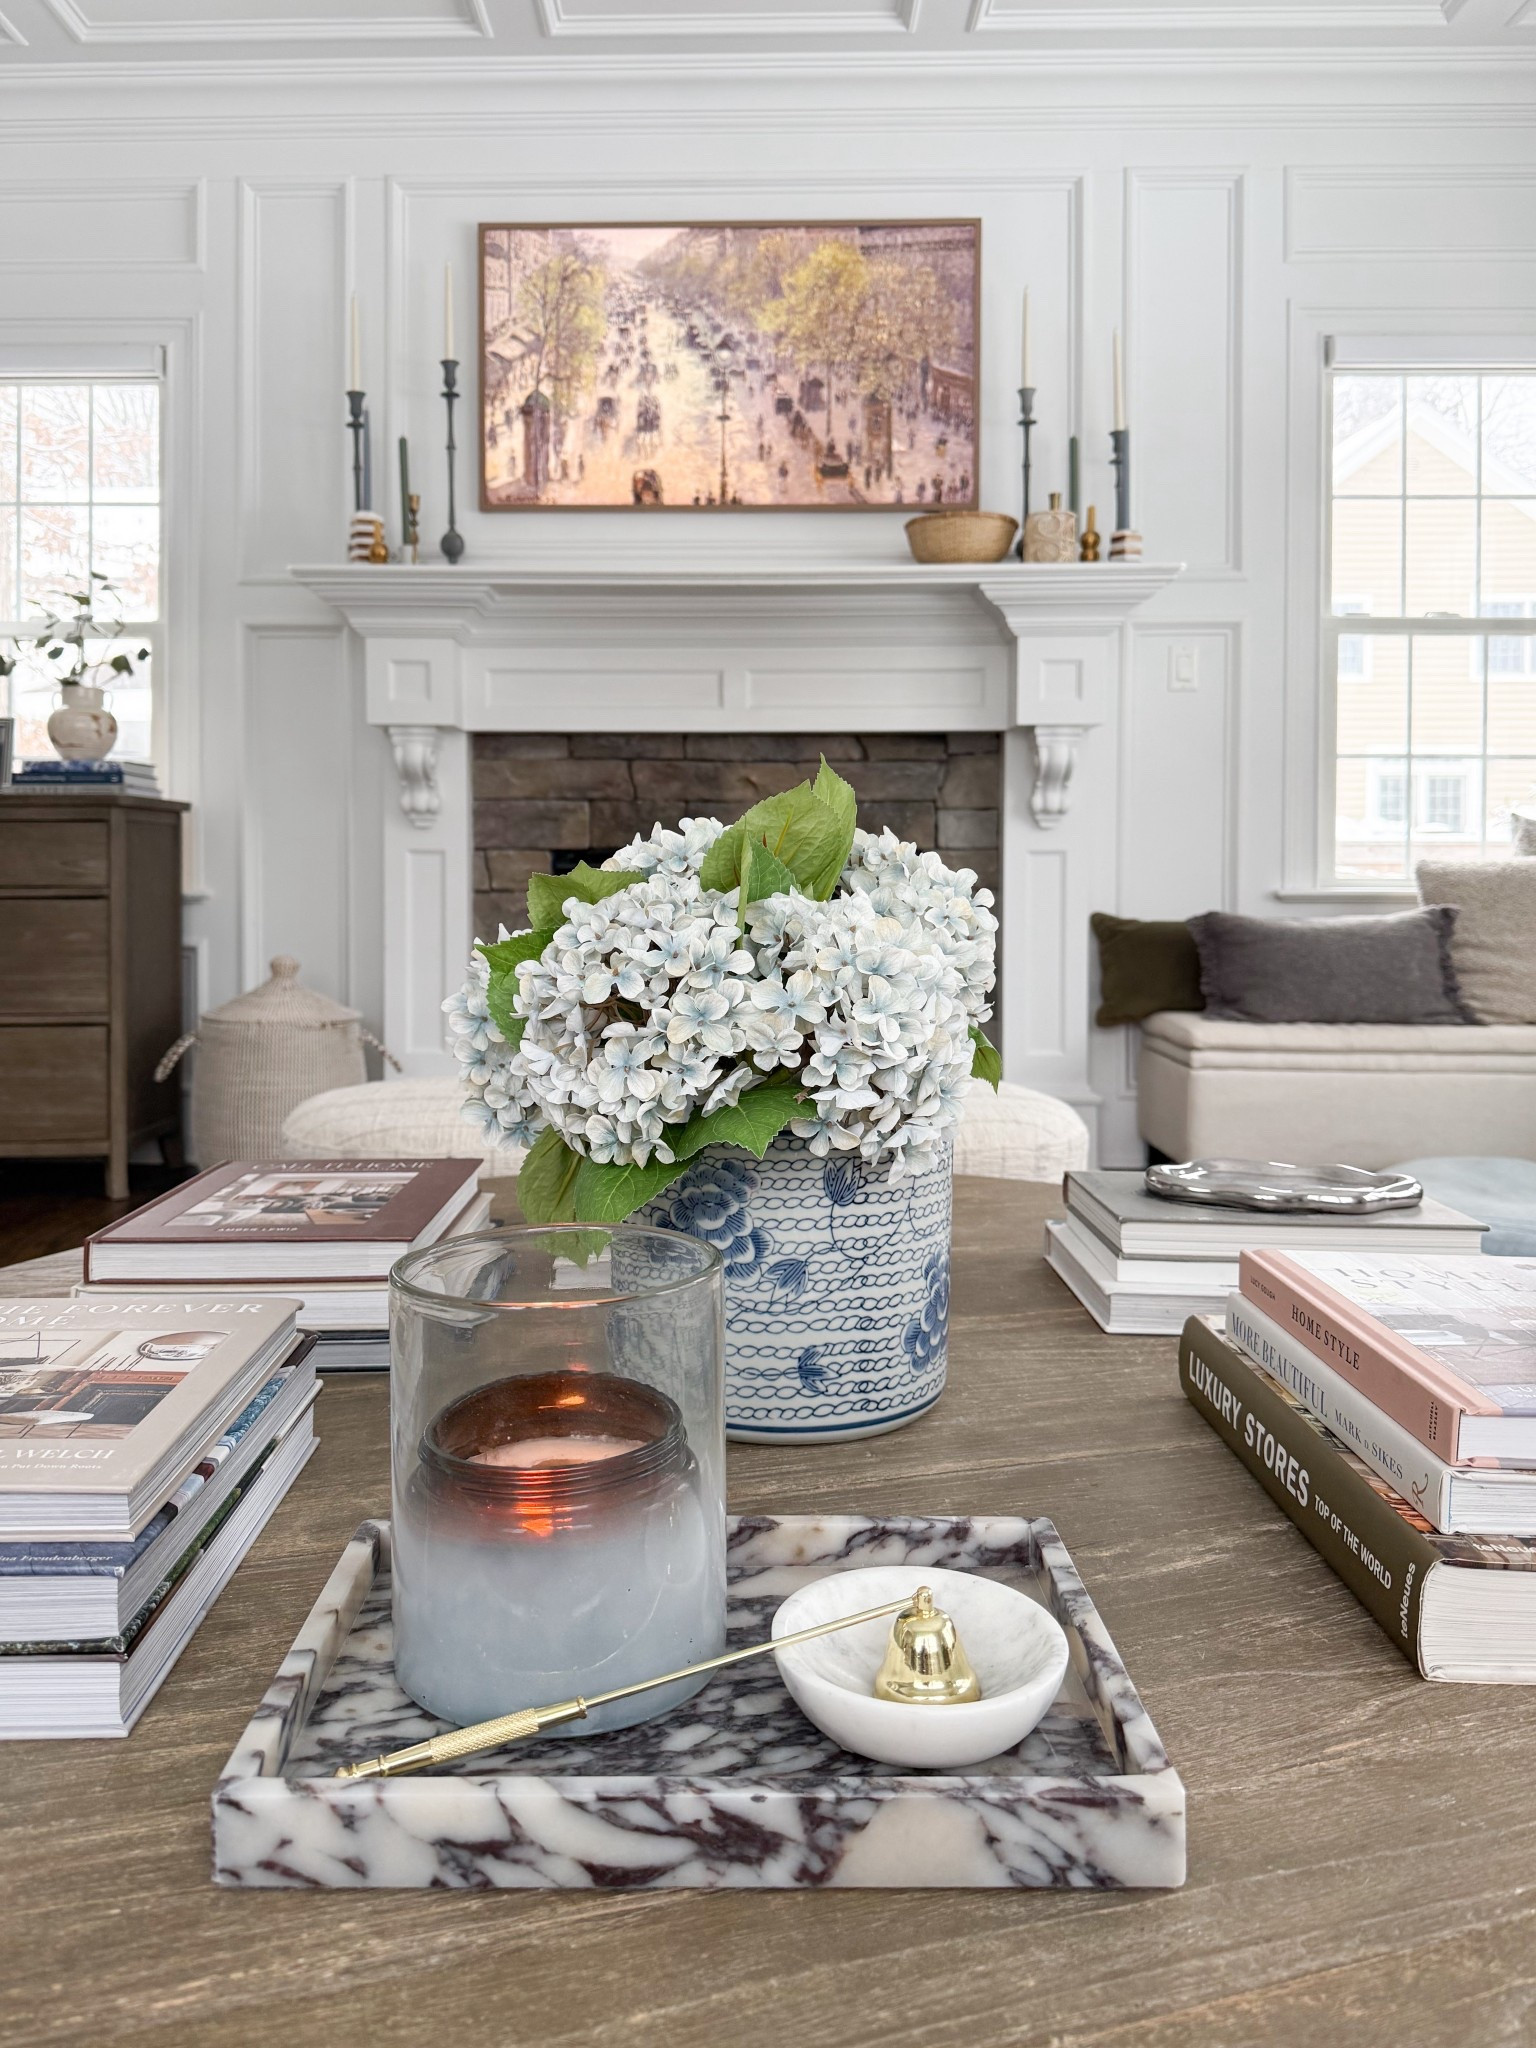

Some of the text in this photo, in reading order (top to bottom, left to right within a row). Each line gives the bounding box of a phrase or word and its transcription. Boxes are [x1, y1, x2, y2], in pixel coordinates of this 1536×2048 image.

[1334, 1266, 1508, 1282] HOME
[1250, 1275, 1261, 1290] LUCY
[62, 1303, 263, 1314] FOREVER
[0, 1316, 76, 1325] ME
[1291, 1303, 1360, 1370] HOME STYLE
[1231, 1312, 1260, 1356] MORE
[1262, 1339, 1328, 1418] BEAUTIFUL
[1335, 1408, 1363, 1445] MARK
[1371, 1443, 1404, 1480] SIKES
[16, 1449, 115, 1459] WELCH
[1188, 1350, 1392, 1590] LUXURY STORES TOP OF THE WORLD
[20, 1554, 113, 1562] Freudenberger
[1400, 1562, 1416, 1639] teNeues
